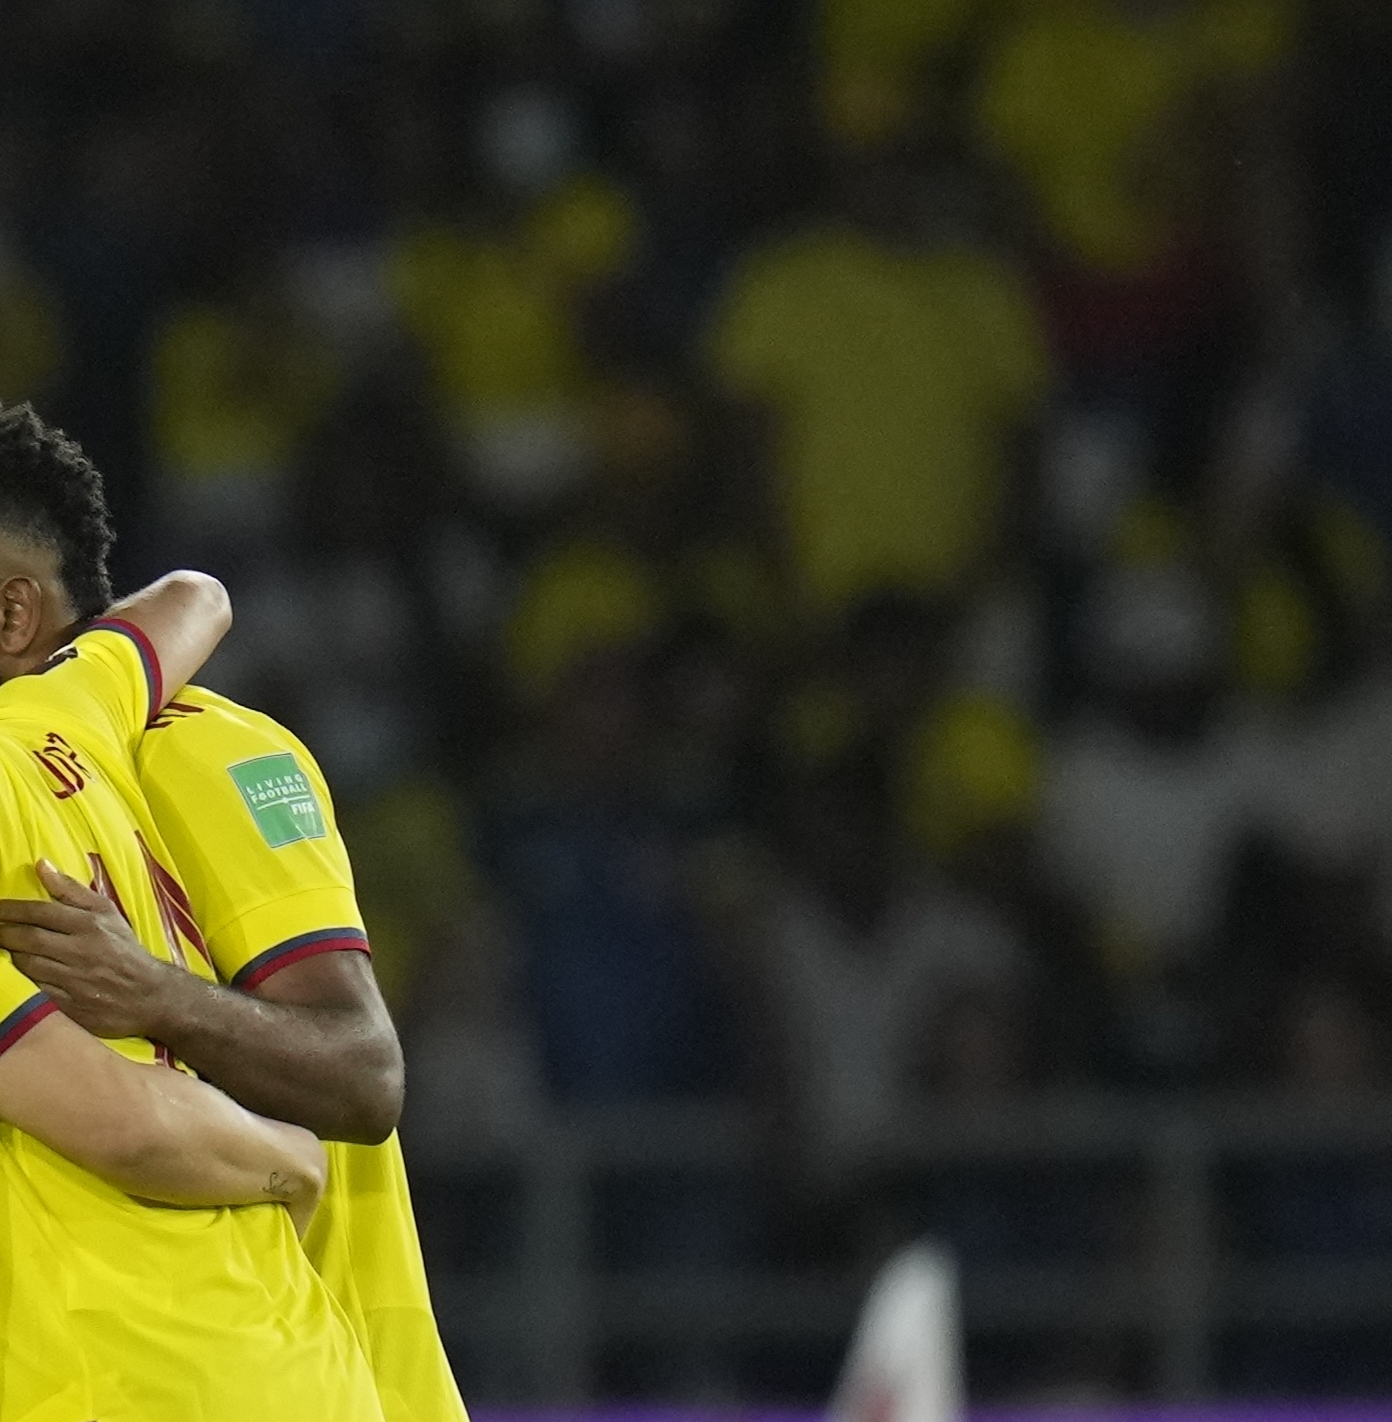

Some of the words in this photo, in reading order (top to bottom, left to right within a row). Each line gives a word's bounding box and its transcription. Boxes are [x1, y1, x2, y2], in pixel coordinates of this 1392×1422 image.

[245, 773, 304, 795] LIVING
[250, 783, 308, 804] FOOTBALL
[290, 801, 315, 815] FIFA
